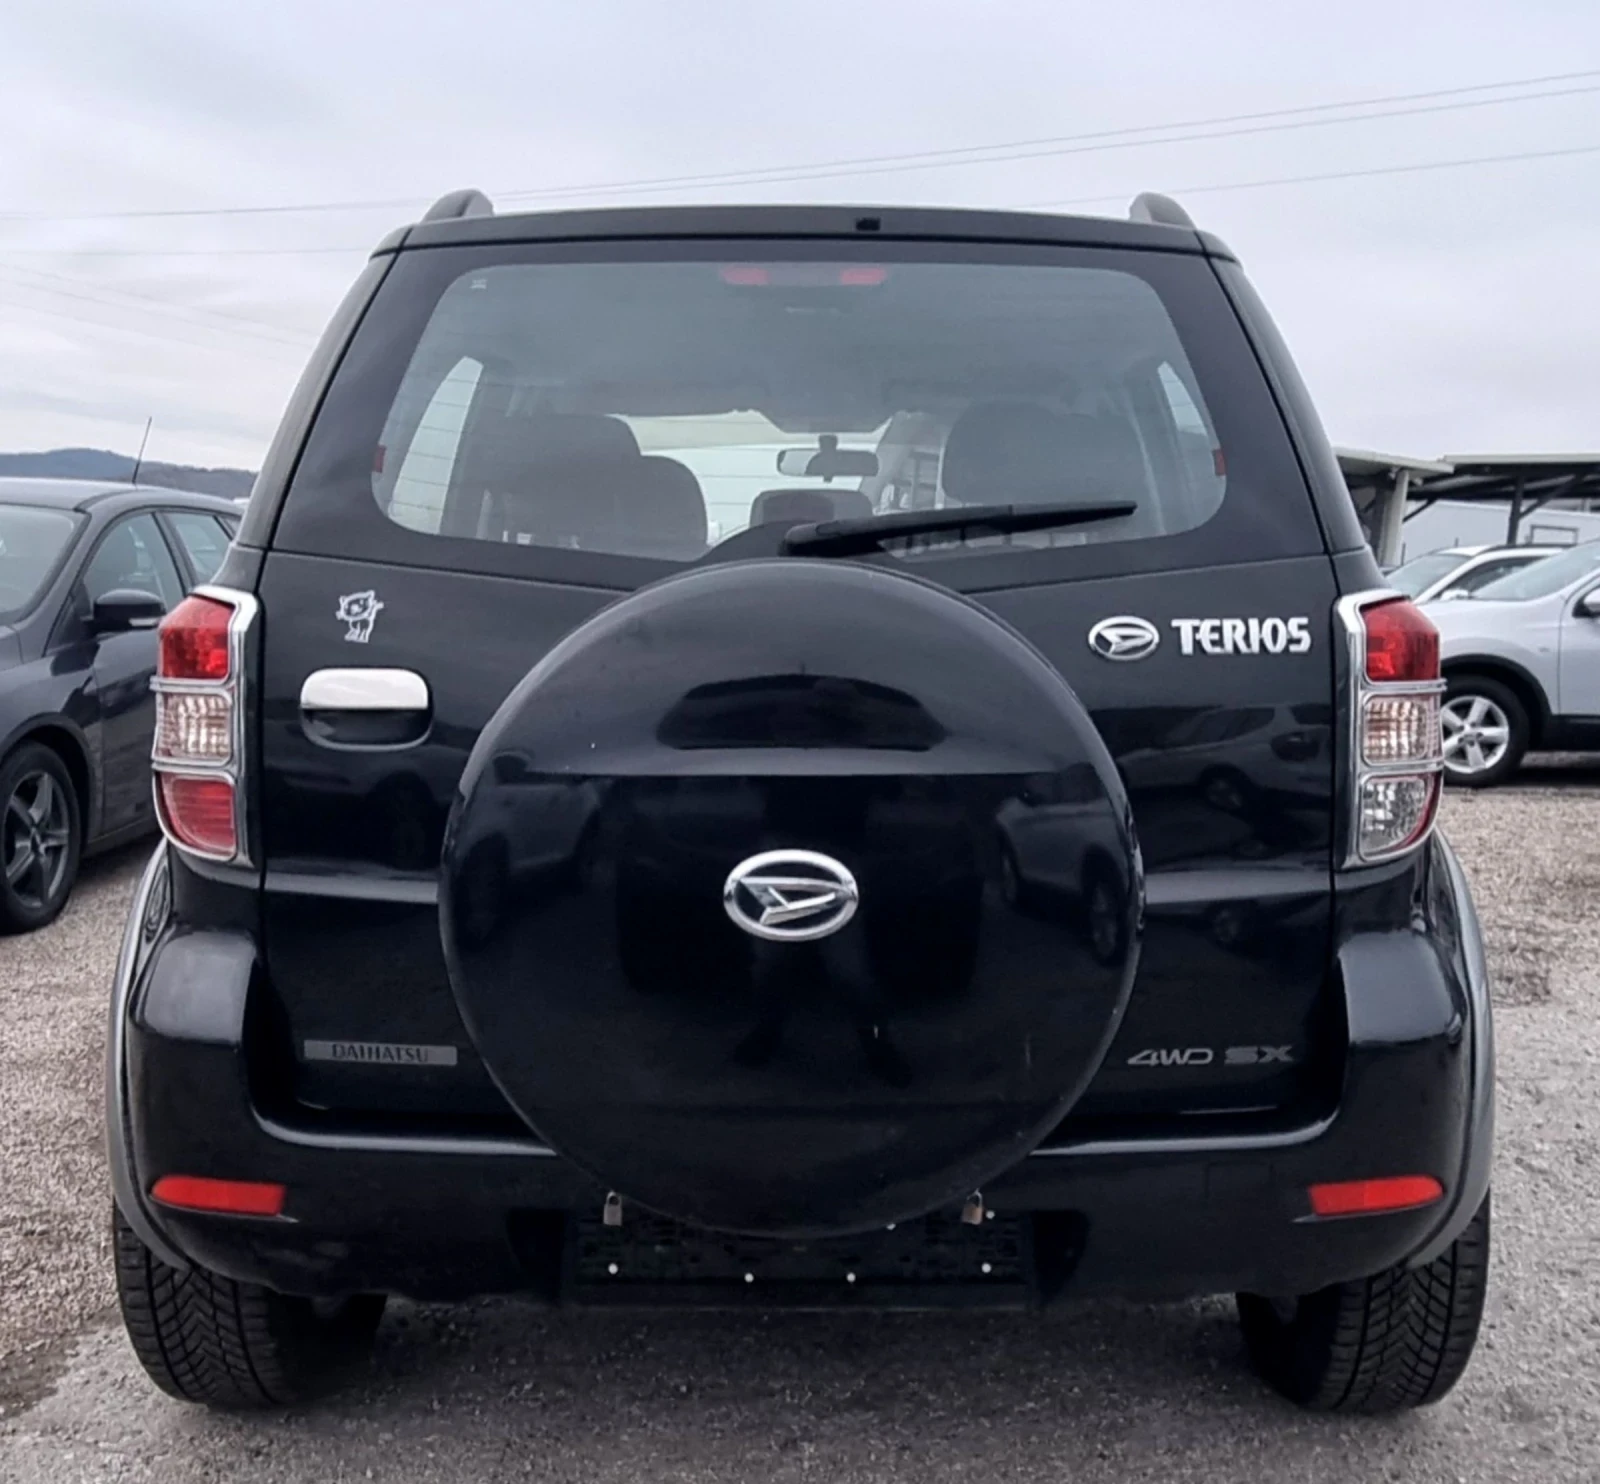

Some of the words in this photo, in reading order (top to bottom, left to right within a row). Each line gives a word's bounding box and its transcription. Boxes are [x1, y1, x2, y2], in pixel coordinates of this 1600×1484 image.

[1171, 616, 1311, 655] TERIOS
[331, 1042, 429, 1062] DAIHATSU
[1126, 1047, 1214, 1065] 4WD
[1223, 1045, 1294, 1065] SX
